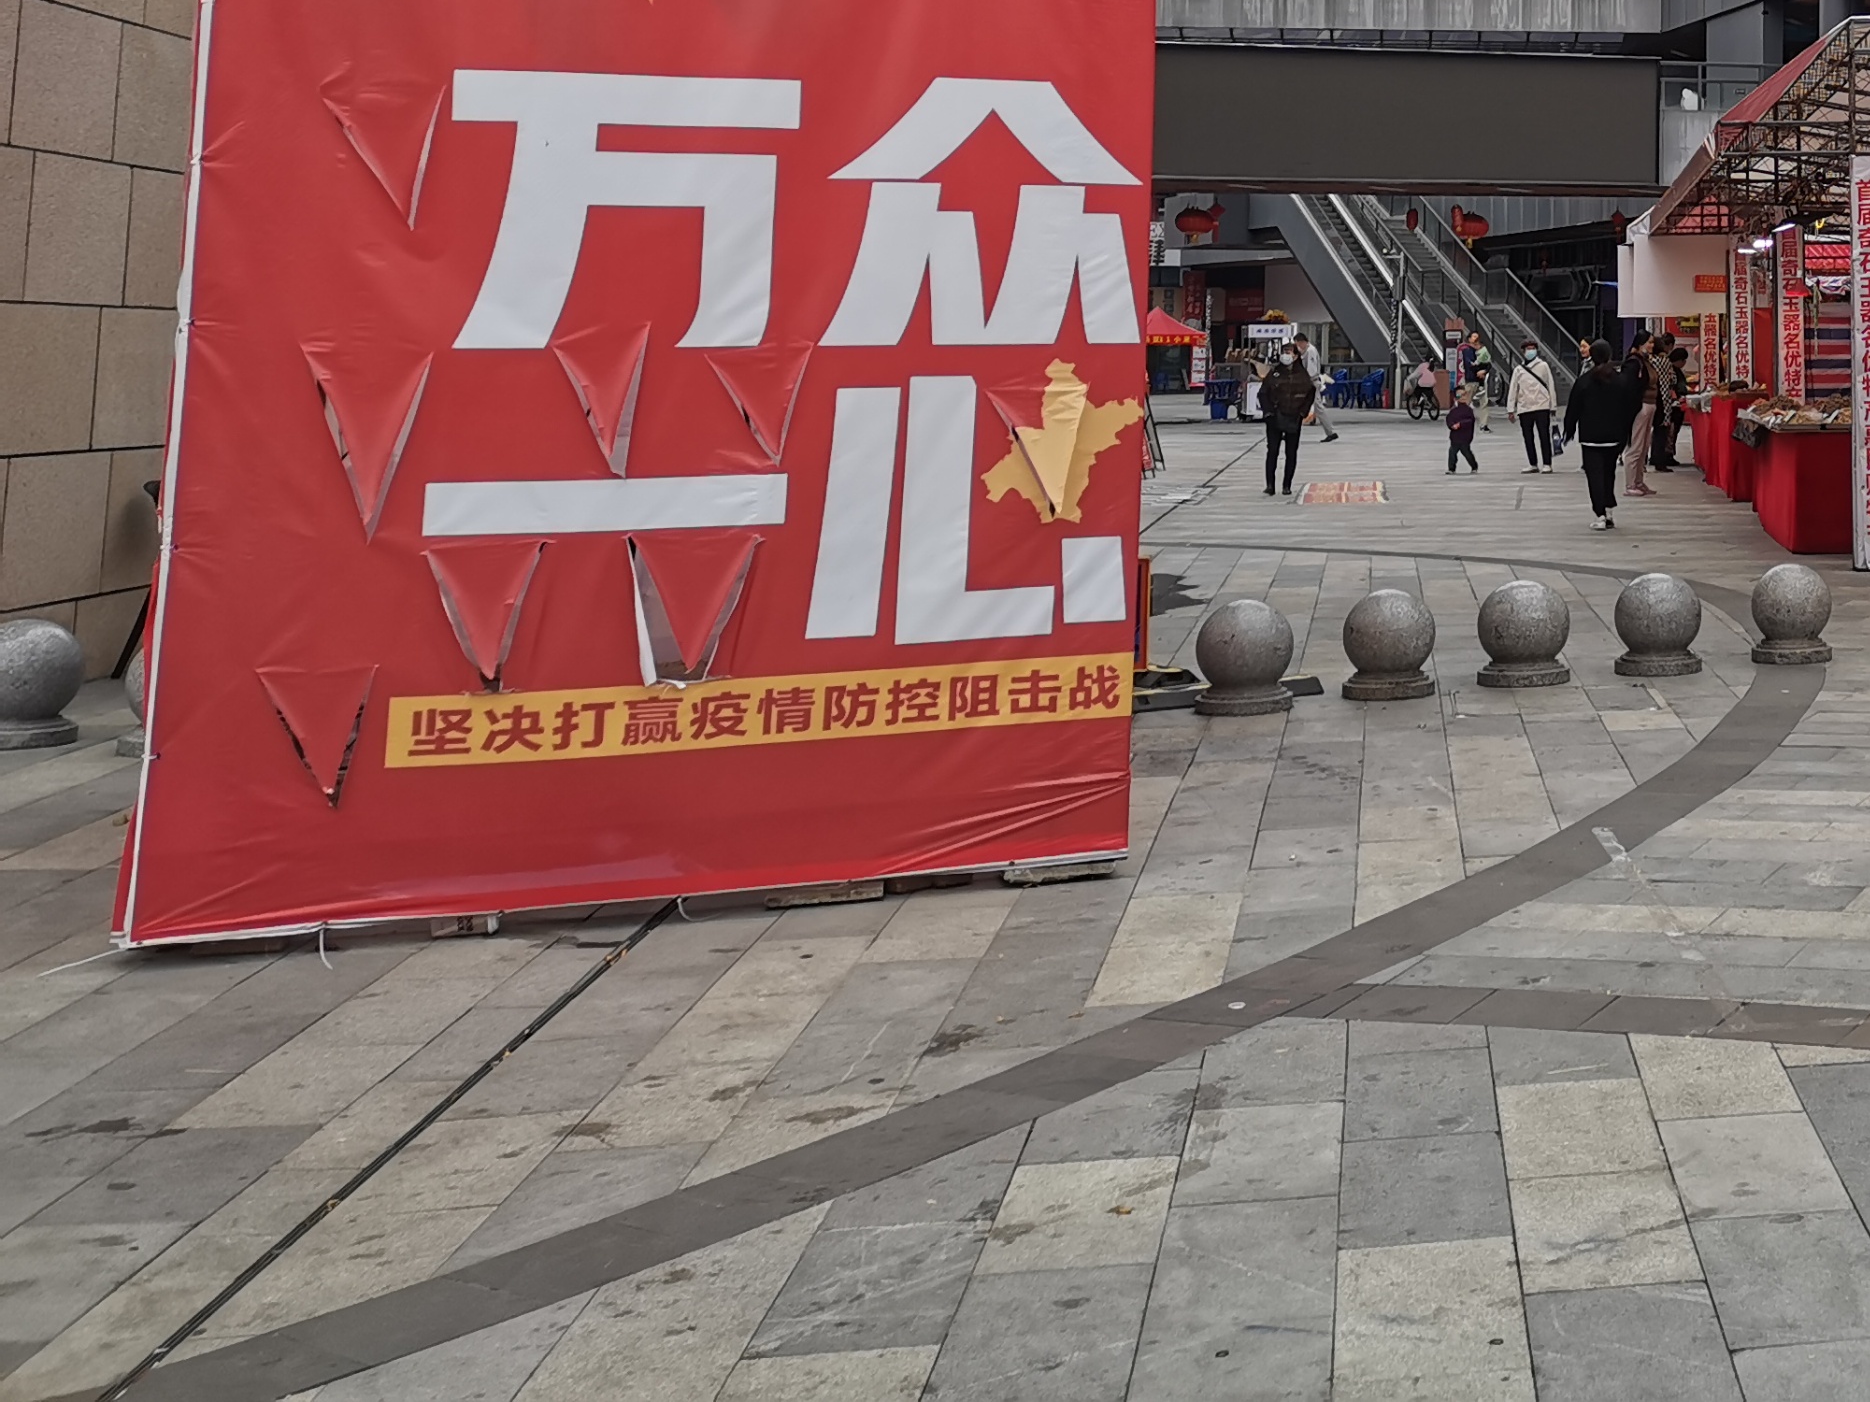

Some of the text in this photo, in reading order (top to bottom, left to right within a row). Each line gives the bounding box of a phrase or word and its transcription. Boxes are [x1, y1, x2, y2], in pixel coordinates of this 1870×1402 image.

[452, 69, 1143, 348] 万众
[421, 375, 1127, 645] 一心
[408, 666, 1121, 757] 坚决打赢疫情防控阻击战
